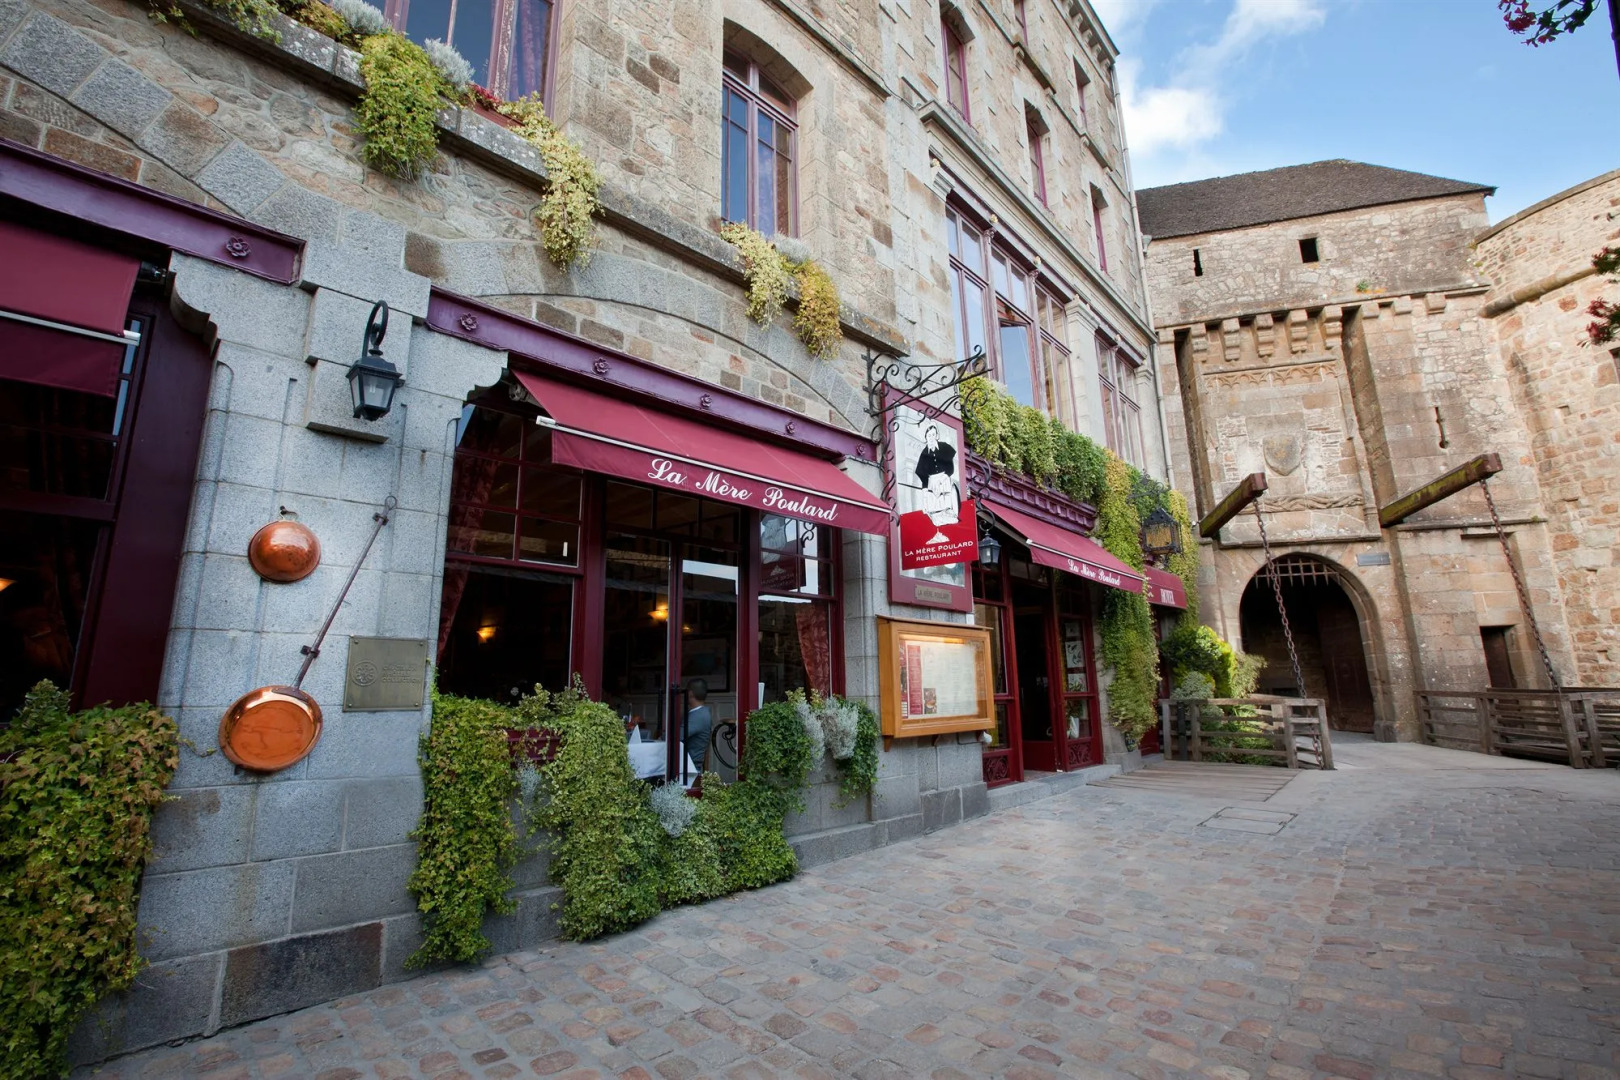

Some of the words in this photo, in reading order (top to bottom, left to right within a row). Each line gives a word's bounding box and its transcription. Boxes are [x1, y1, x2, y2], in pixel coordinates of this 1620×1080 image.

[648, 458, 687, 486] La
[695, 471, 752, 500] Mère
[763, 486, 838, 521] Poulard
[915, 547, 936, 555] MÈRE
[938, 540, 974, 551] POULARD
[916, 550, 962, 561] RESTAURANT
[1068, 558, 1079, 573] La
[1098, 569, 1121, 586] Poulard
